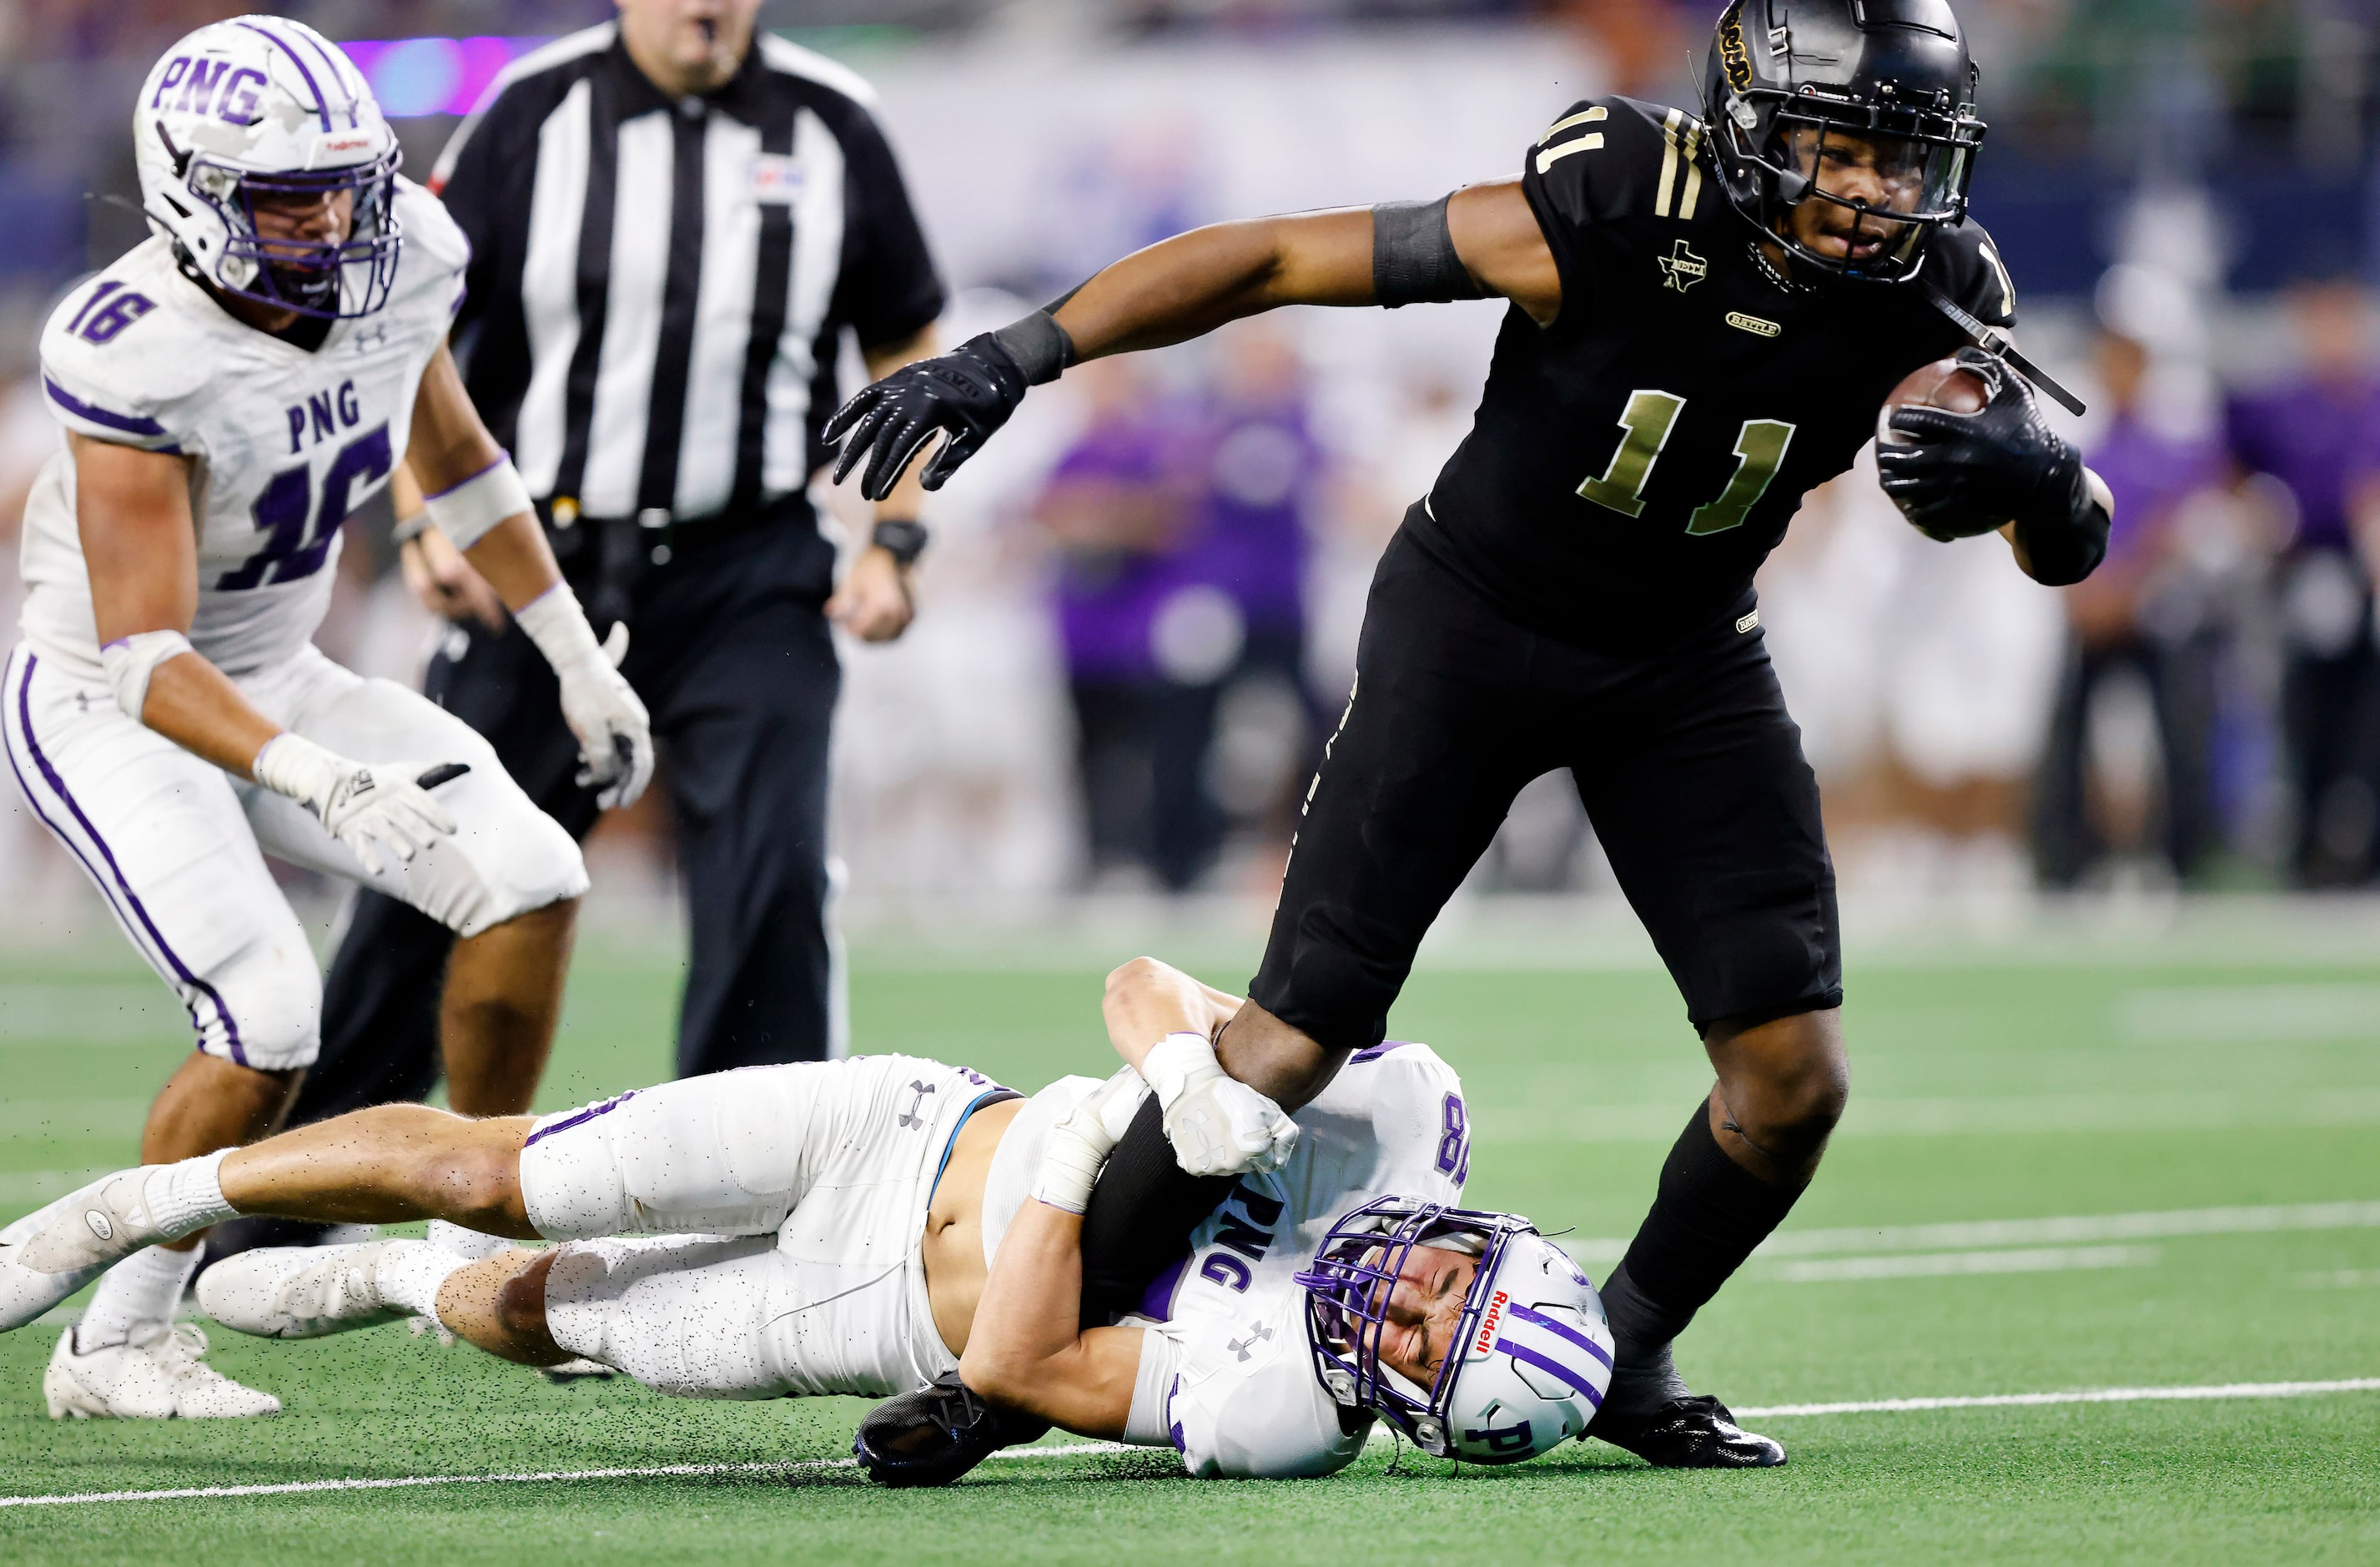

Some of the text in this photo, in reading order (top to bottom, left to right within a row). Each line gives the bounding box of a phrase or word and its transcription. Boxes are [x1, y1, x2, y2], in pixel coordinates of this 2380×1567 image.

[152, 57, 268, 126] PNG
[1536, 106, 1608, 174] 11
[1671, 259, 1706, 277] MECCA
[64, 280, 158, 346] 16
[1730, 315, 1778, 335] BATTLE
[286, 379, 360, 455] PNG
[1575, 389, 1797, 536] 11
[1200, 1182, 1285, 1294] PNG
[1476, 1291, 1508, 1353] Riddell
